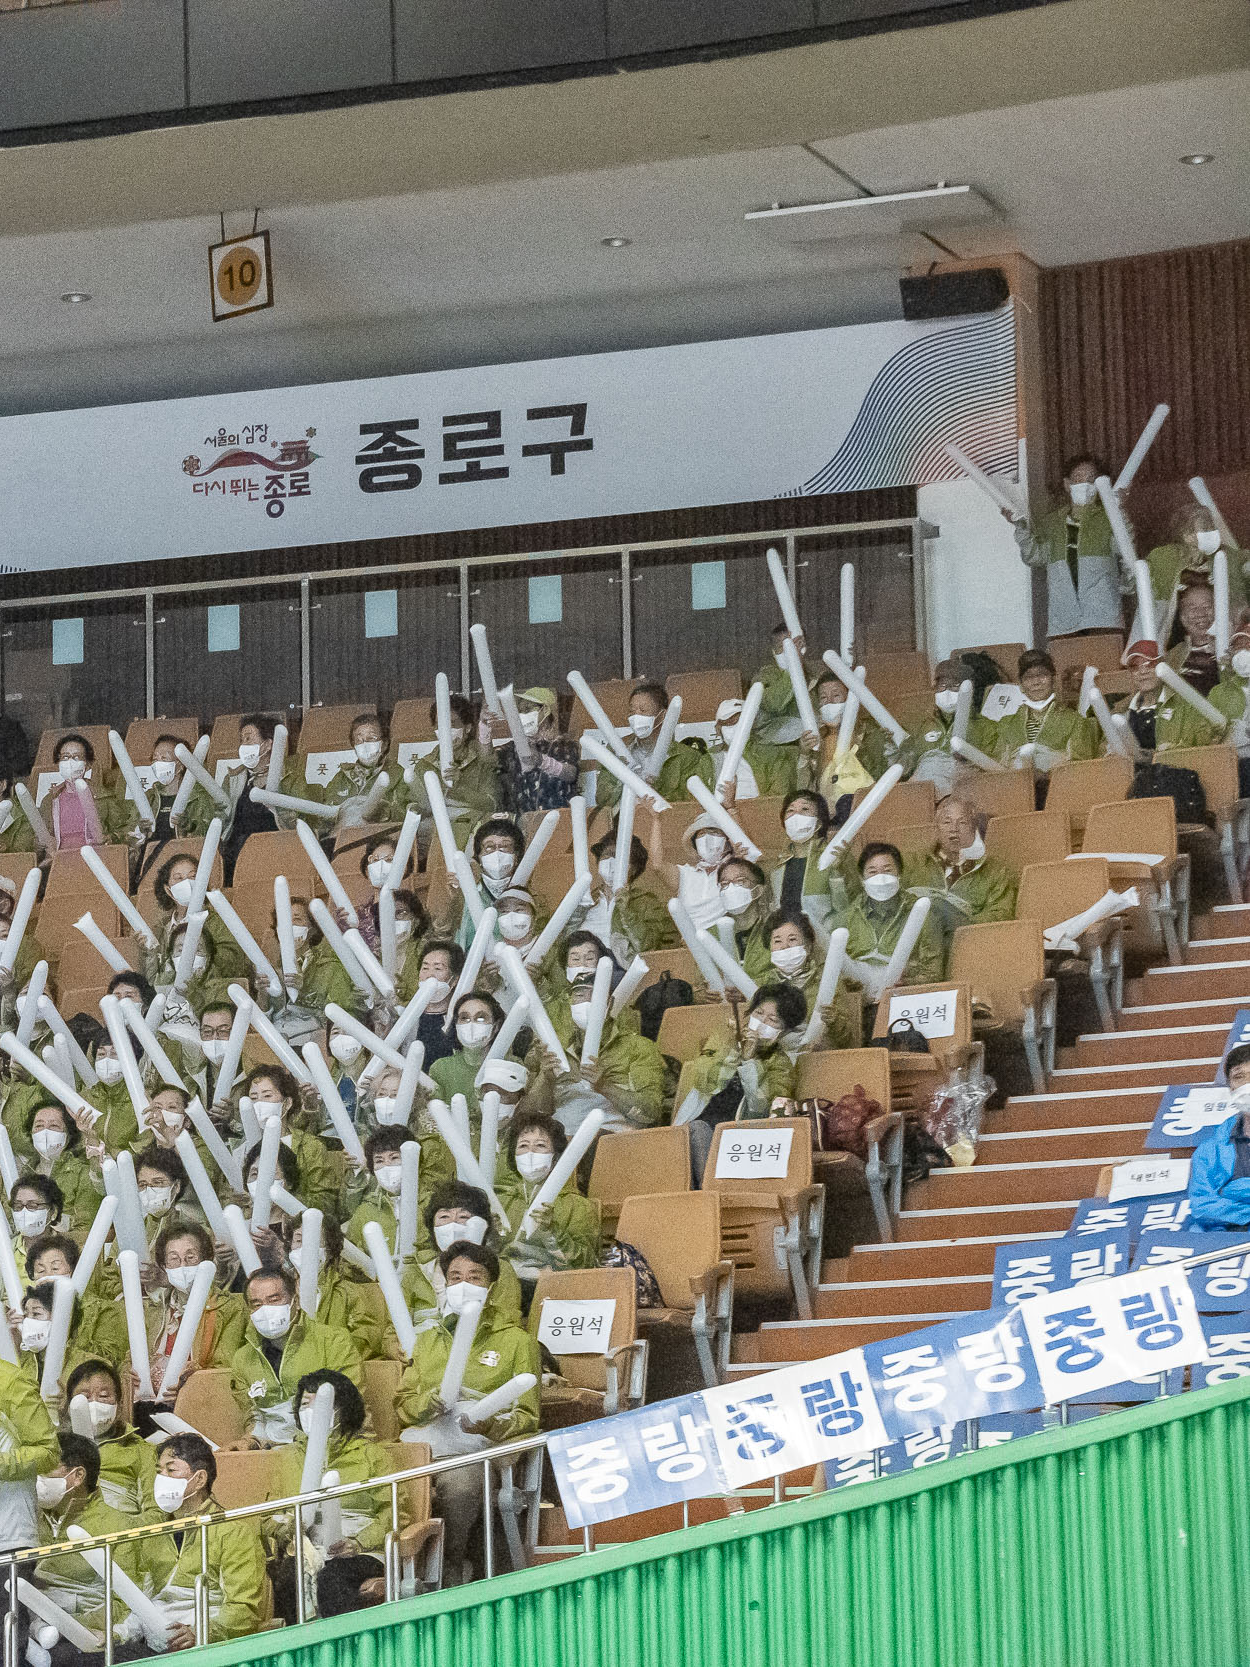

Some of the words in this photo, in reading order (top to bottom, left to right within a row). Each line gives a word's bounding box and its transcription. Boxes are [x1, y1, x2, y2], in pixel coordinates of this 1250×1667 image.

[224, 260, 256, 291] 10
[203, 427, 240, 448] 서울의
[241, 423, 269, 445] 심장
[355, 402, 594, 494] 종로구
[192, 479, 226, 496] 다시
[229, 478, 260, 501] 뛰는
[263, 471, 312, 519] 종로
[899, 1003, 947, 1027] 응원석
[726, 1143, 782, 1163] 응원석
[547, 1315, 604, 1337] 응원석
[1044, 1285, 1184, 1374] 중랑
[882, 1322, 1027, 1413] 중랑
[726, 1371, 863, 1461] 중랑
[566, 1414, 713, 1504] 중랑
